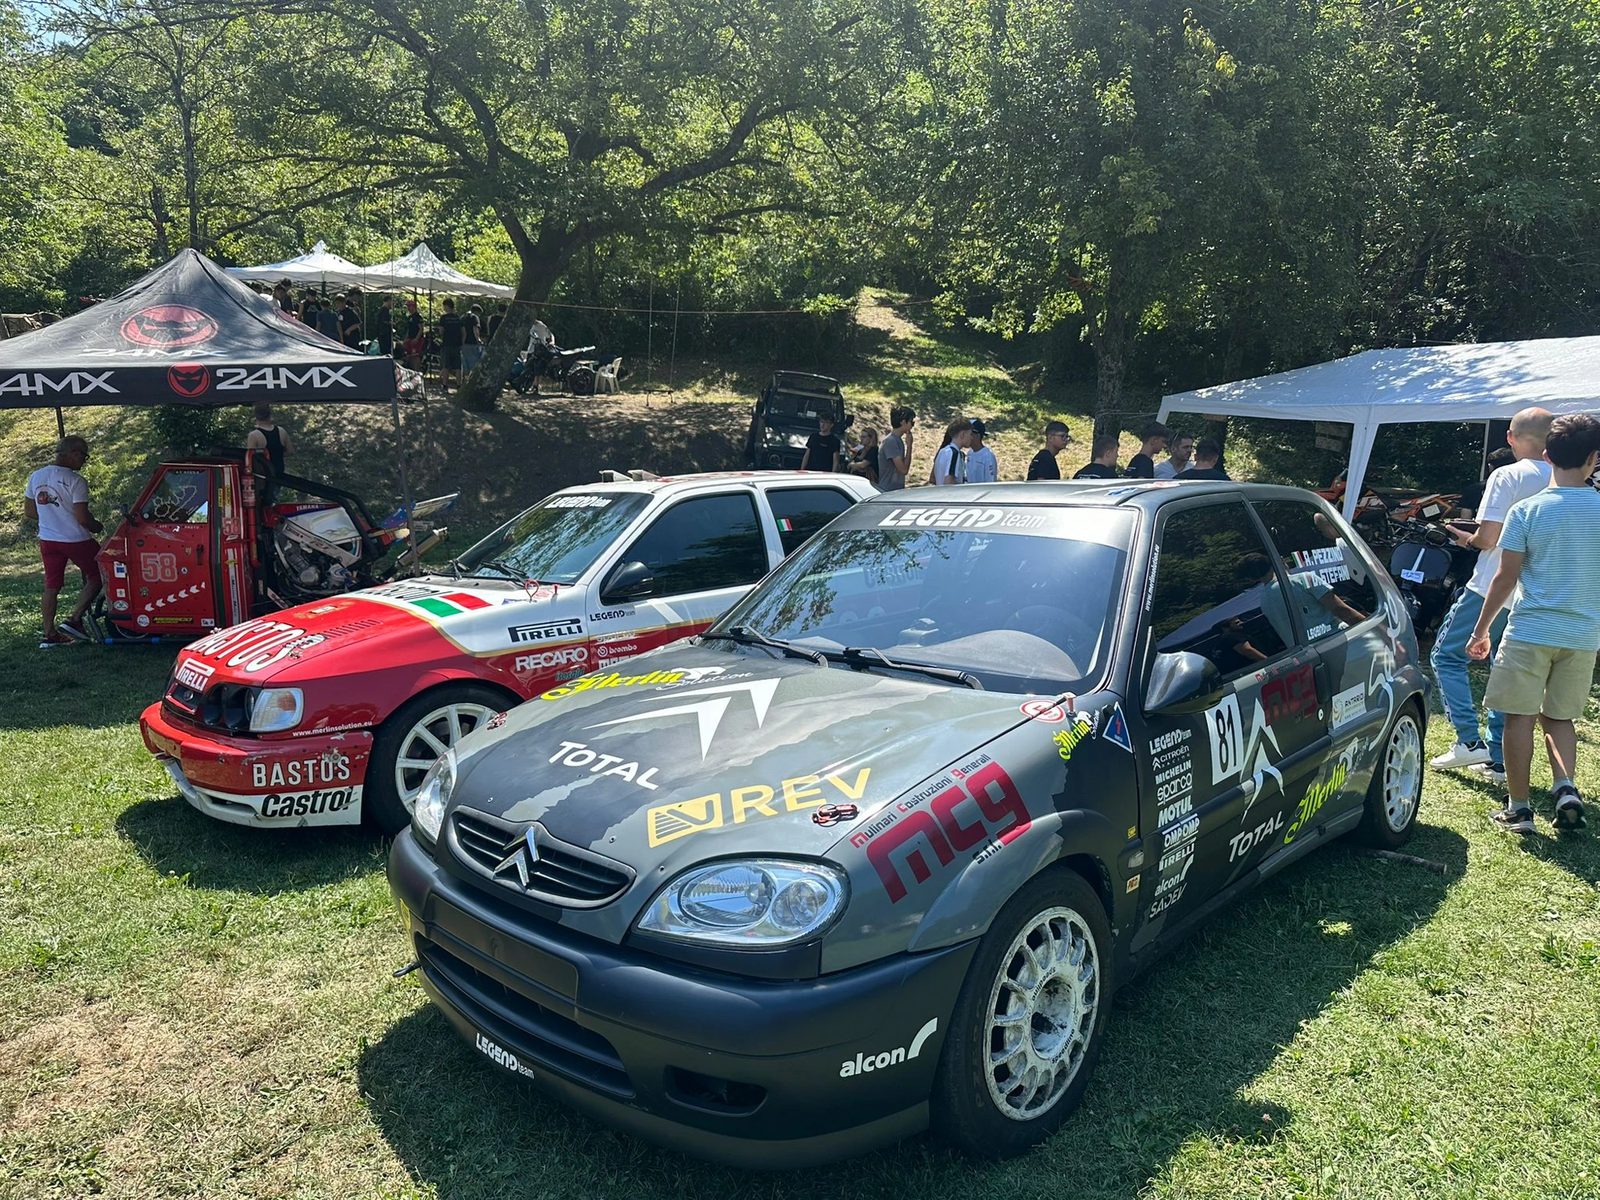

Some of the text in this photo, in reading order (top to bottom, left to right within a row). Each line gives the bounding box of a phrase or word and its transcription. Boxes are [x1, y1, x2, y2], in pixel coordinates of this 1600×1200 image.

[0, 371, 120, 396] 4MX
[216, 366, 357, 390] 24MX
[878, 508, 1047, 528] LEGEND team
[140, 552, 178, 582] 58
[507, 618, 583, 643] PIRELLI
[589, 609, 625, 622] LEGEND
[175, 658, 215, 691] PIRELLI
[515, 647, 588, 672] RECARO
[540, 669, 686, 701] Merlin
[292, 720, 373, 737] www.merlinsolution.eu
[1149, 729, 1182, 755] LEGEND
[1215, 704, 1237, 774] 81
[253, 755, 350, 788] BASTOS
[548, 740, 660, 791] TOTAL
[1155, 760, 1192, 785] MICHELIN
[261, 786, 354, 818] Castrol
[1157, 772, 1193, 805] sparco
[1158, 795, 1193, 828] MOTUL
[1229, 810, 1284, 863] TOTAL
[1159, 836, 1197, 872] PIRELLI
[1154, 873, 1181, 897] alcon
[476, 1032, 535, 1080] LEGEND team
[839, 1046, 906, 1078] alcon
